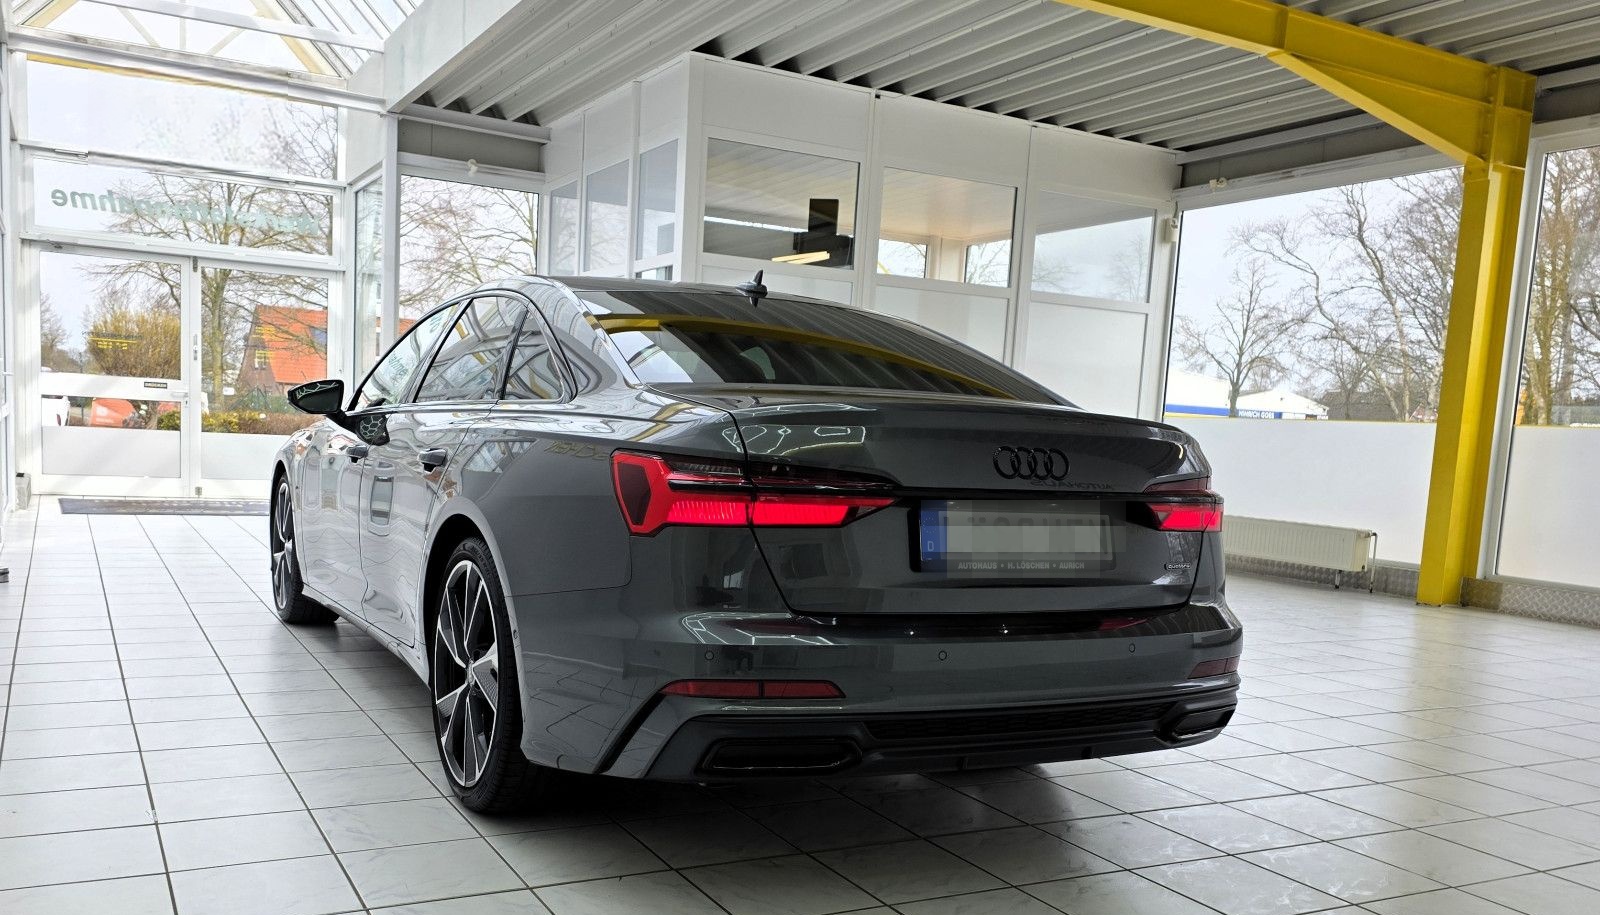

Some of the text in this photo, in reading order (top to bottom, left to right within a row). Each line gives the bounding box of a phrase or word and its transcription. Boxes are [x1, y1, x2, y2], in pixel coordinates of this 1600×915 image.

[927, 540, 935, 552] D
[958, 561, 998, 570] AUTOHAUS
[1016, 560, 1050, 570] LÖSCHEN
[1059, 561, 1085, 570] AURICH
